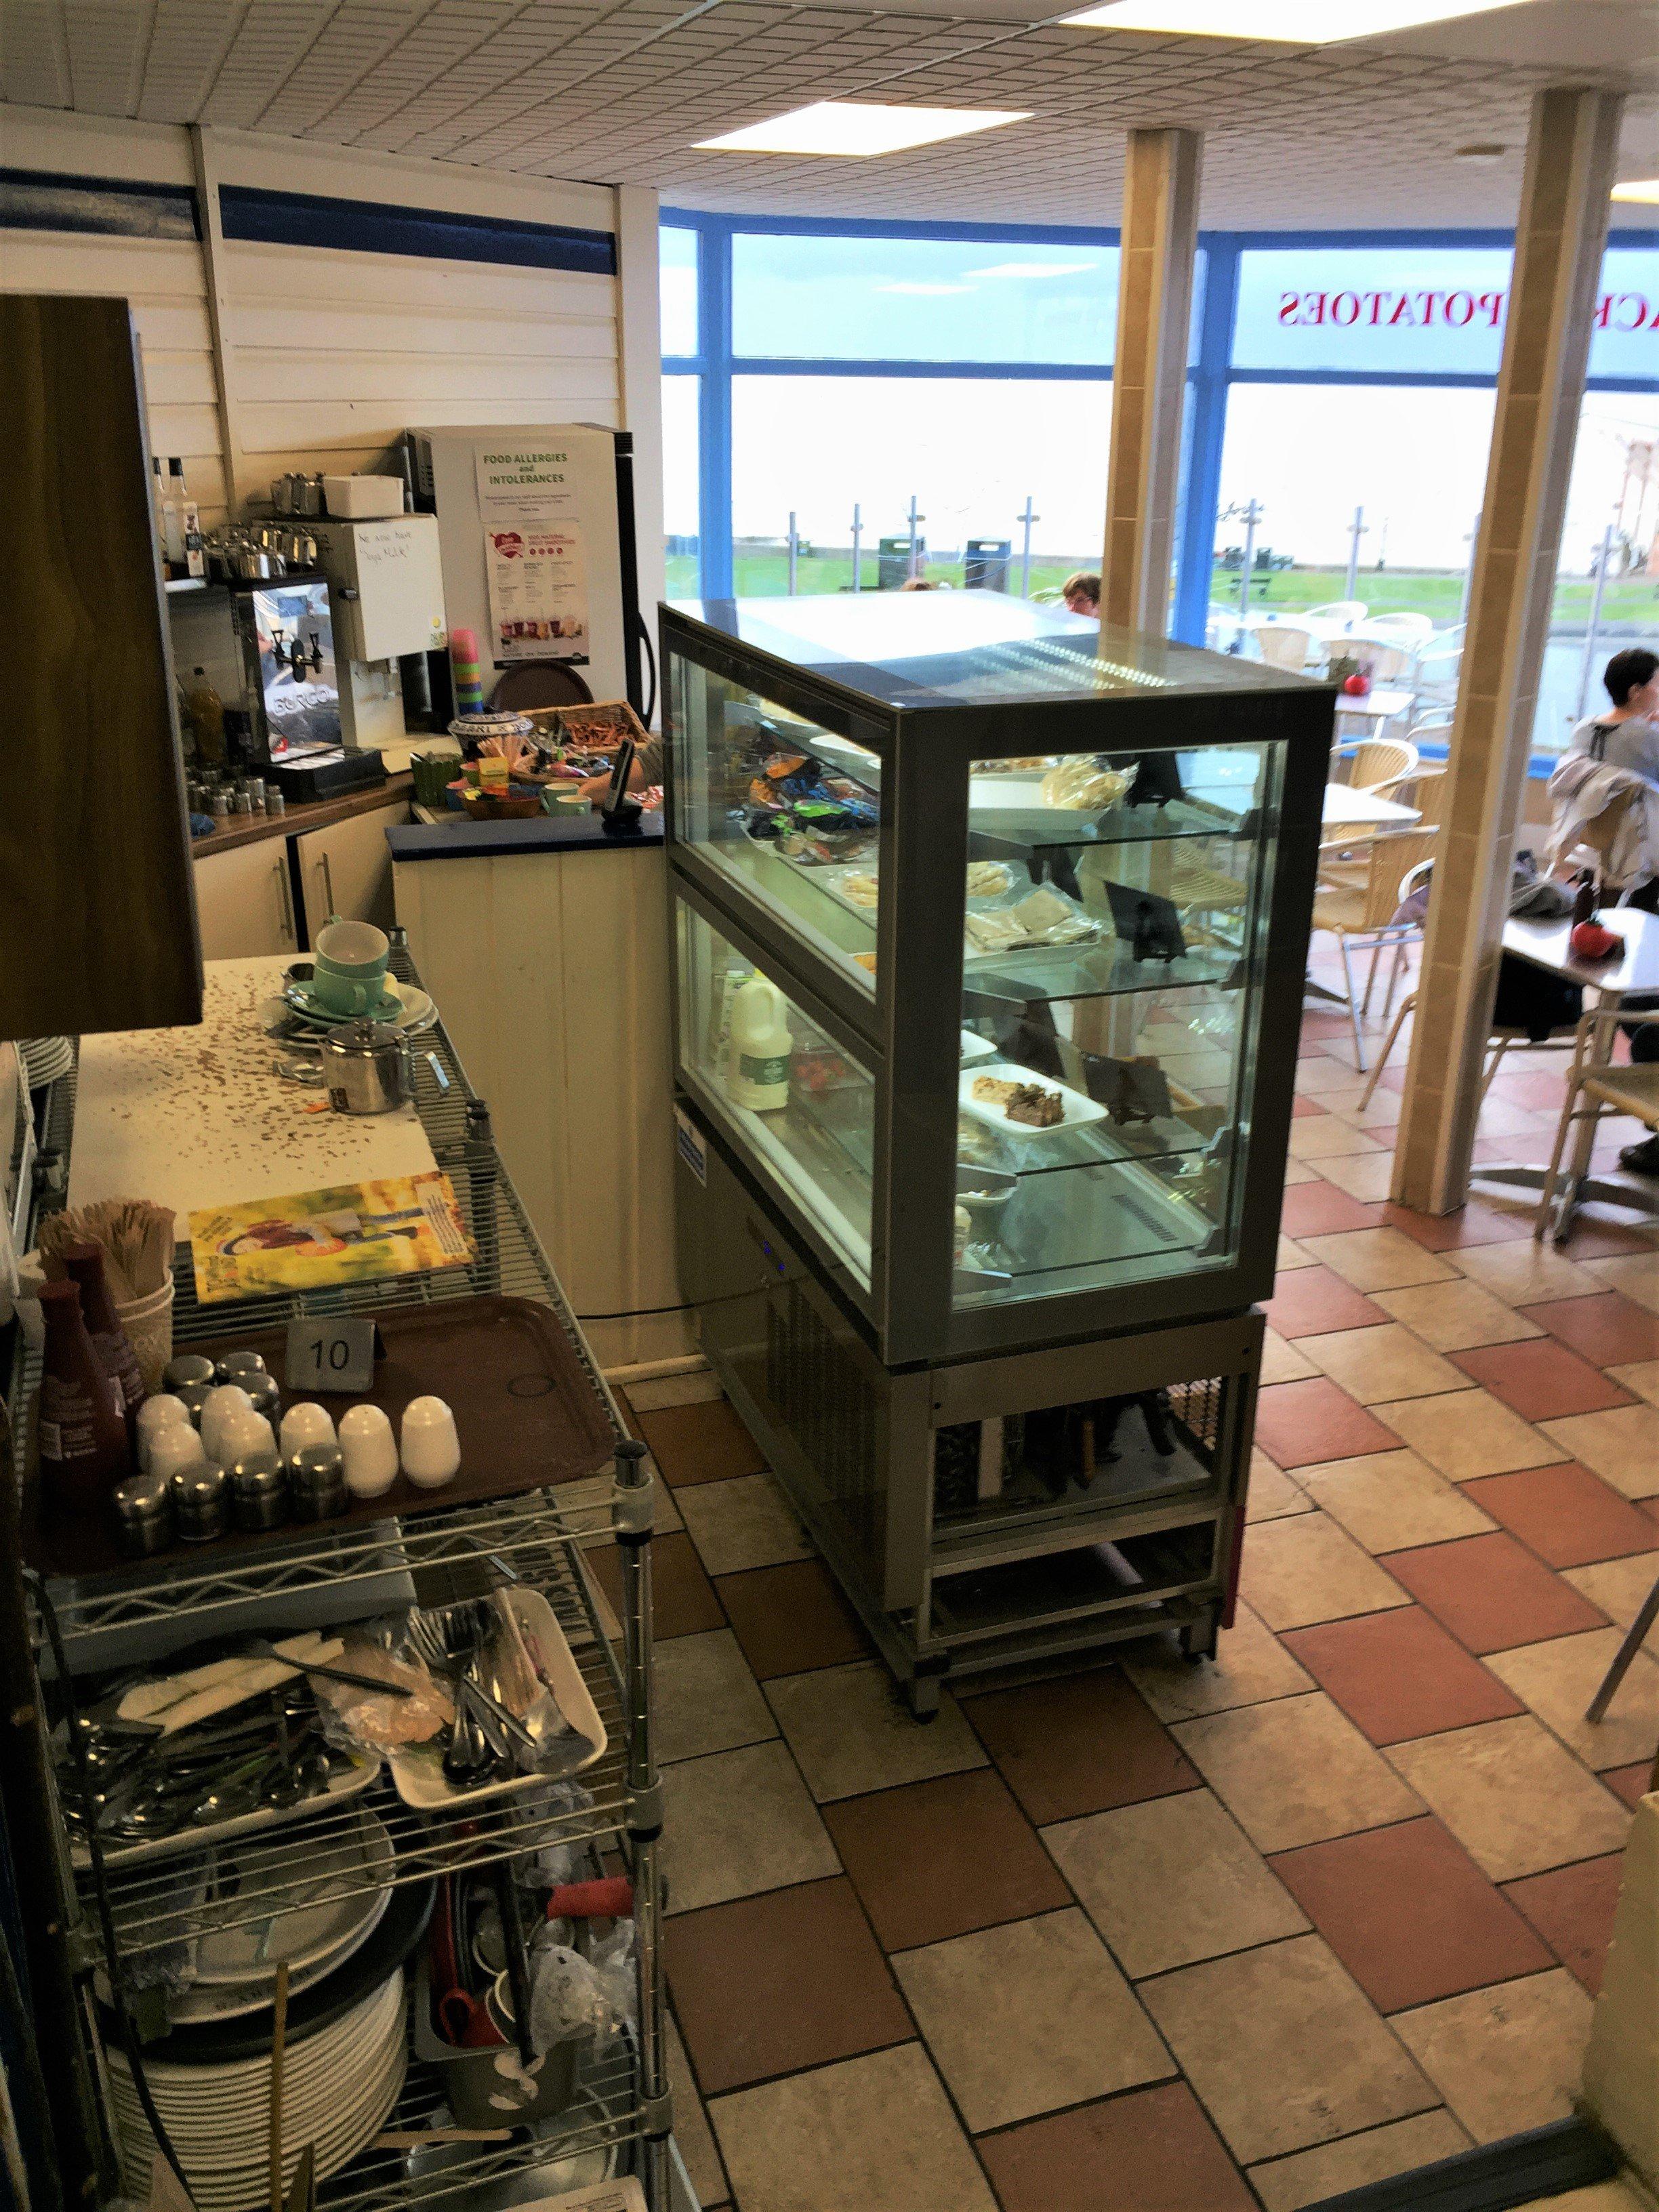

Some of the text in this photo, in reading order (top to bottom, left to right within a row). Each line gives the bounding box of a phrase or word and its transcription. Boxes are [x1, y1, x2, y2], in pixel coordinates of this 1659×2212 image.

[483, 453, 568, 464] FOOD ALLERGIES
[489, 474, 565, 485] INTOLERANCES
[310, 1340, 350, 1370] 10
